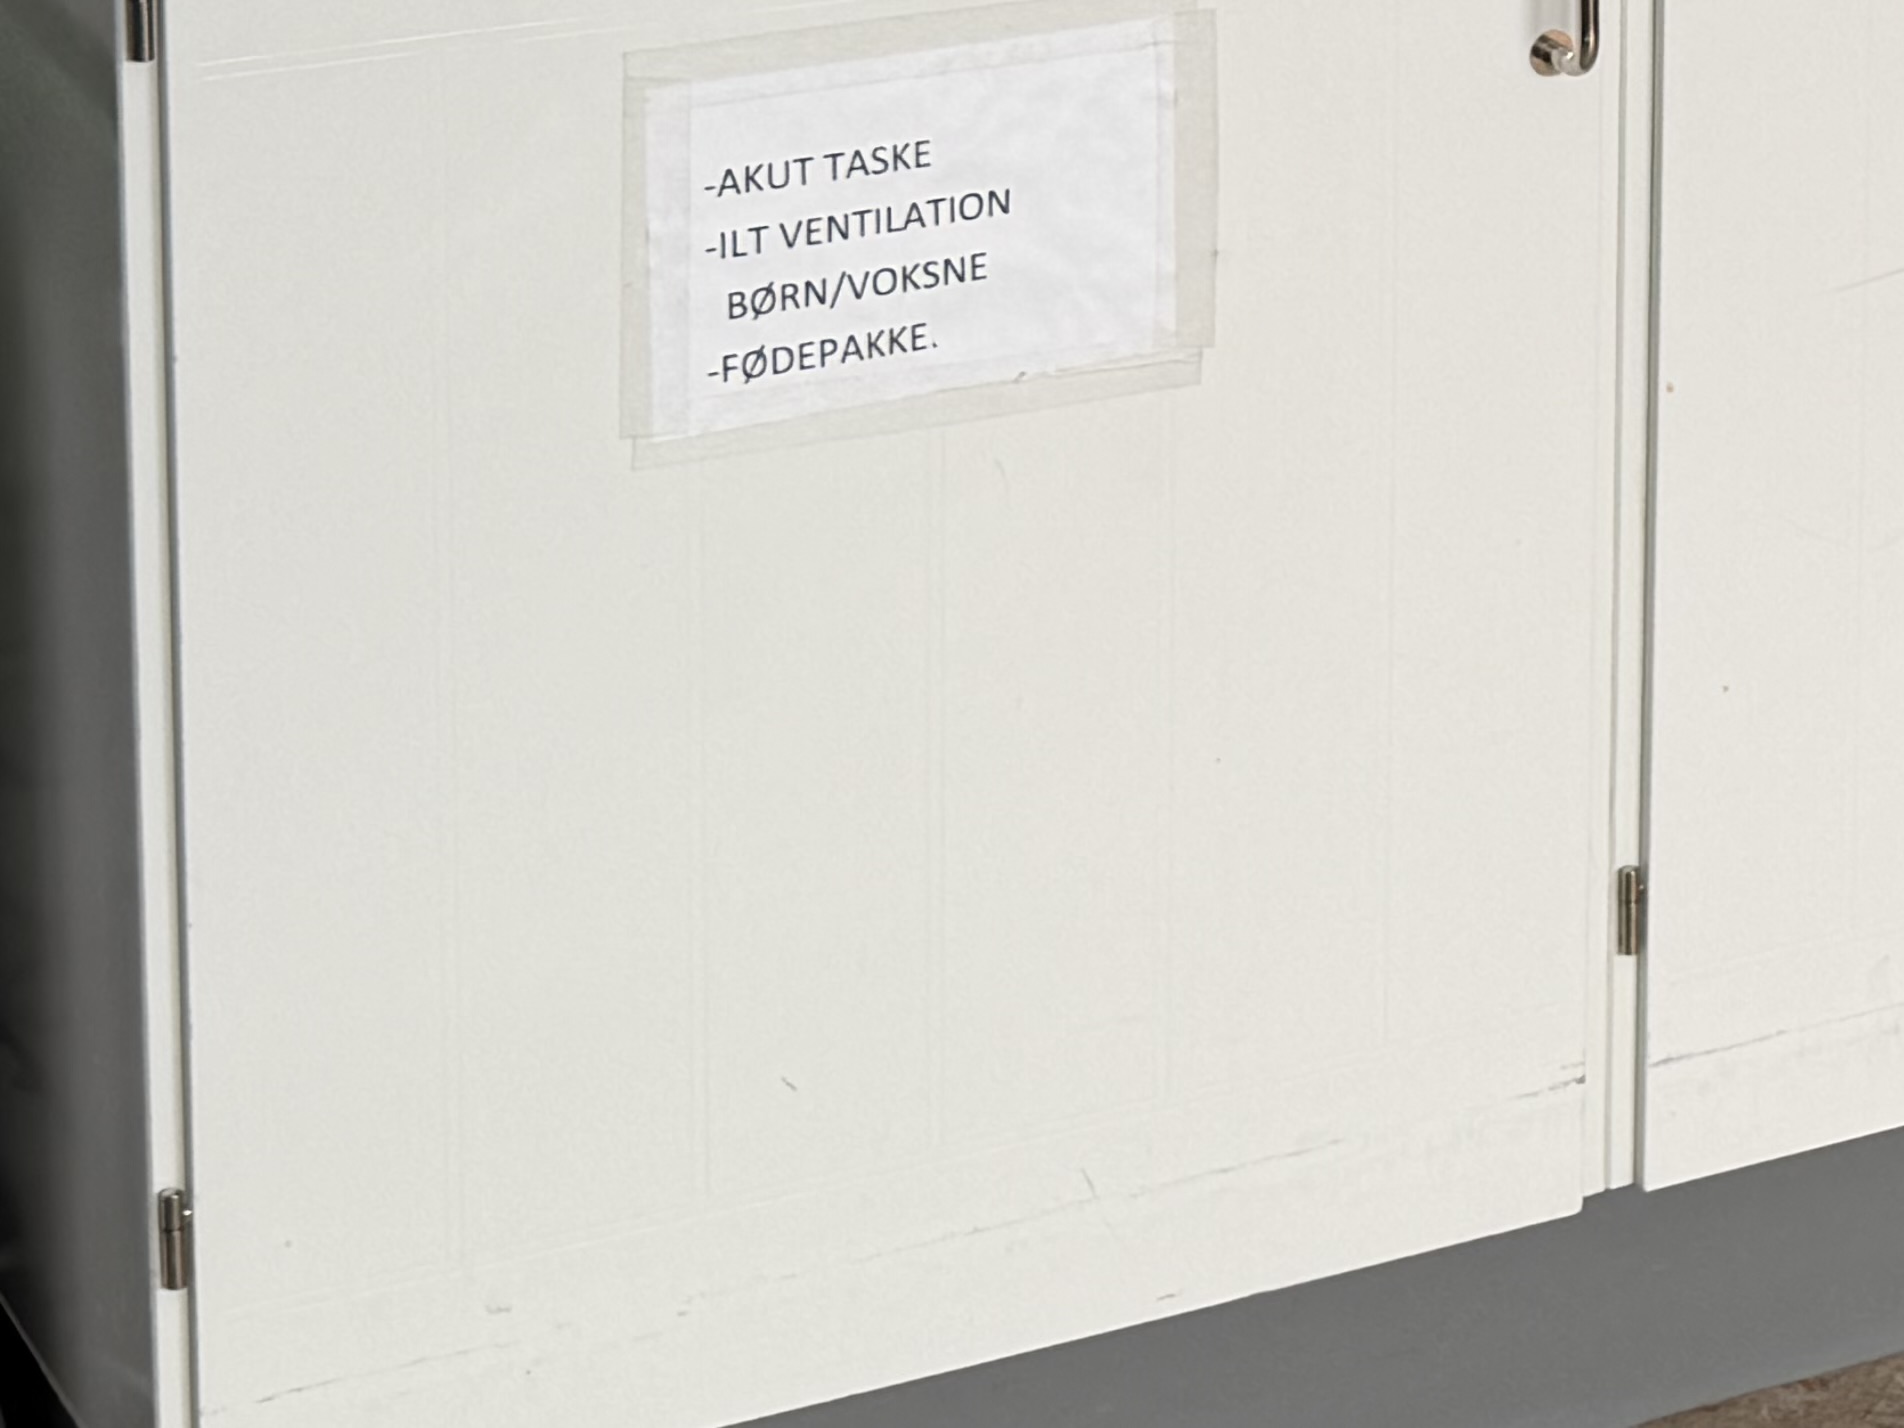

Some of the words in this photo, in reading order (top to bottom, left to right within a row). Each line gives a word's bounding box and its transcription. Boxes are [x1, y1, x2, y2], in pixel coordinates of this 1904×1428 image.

[704, 156, 814, 198] -AKUT
[824, 139, 933, 181] TASKE
[705, 225, 769, 260] -ILT
[780, 189, 1012, 249] VENTILATION
[727, 253, 989, 322] BØRN/VOKSNE
[707, 323, 938, 384] -FØDEPAKKE.
